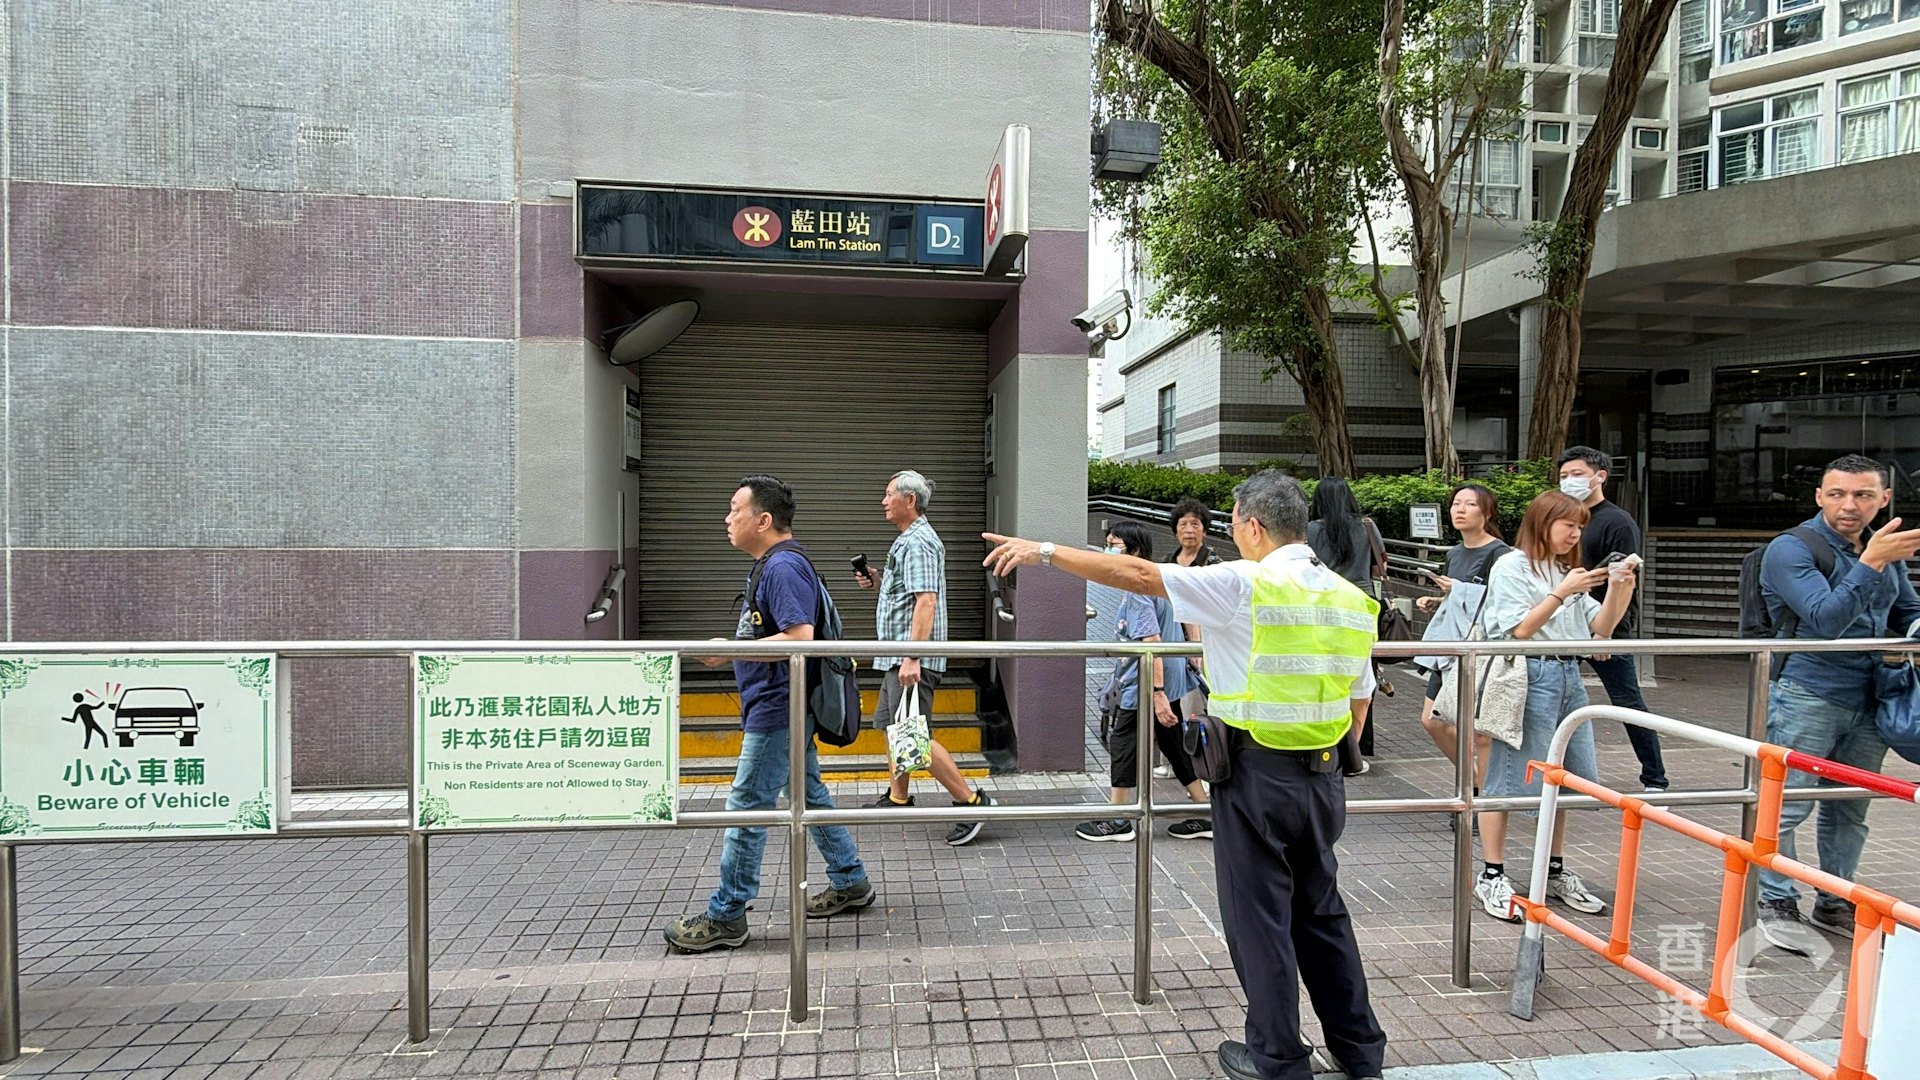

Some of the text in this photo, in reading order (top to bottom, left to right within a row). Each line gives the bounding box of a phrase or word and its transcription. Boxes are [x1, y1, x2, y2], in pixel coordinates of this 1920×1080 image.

[790, 209, 871, 236] 藍田站
[789, 236, 881, 252] Lam Tin Station
[429, 696, 662, 718] 此乃滙景花園私人地方
[442, 727, 651, 750] 非本苑住戶請勿逗留
[63, 757, 206, 787] 小心車輛
[427, 758, 665, 771] This is the Private Area of Sceneway Garden.
[444, 778, 651, 790] Non Residents are not Allowed to Stay.
[37, 791, 231, 811] Beware of Vehicle
[147, 821, 181, 832] Garden
[559, 813, 590, 823] Garden
